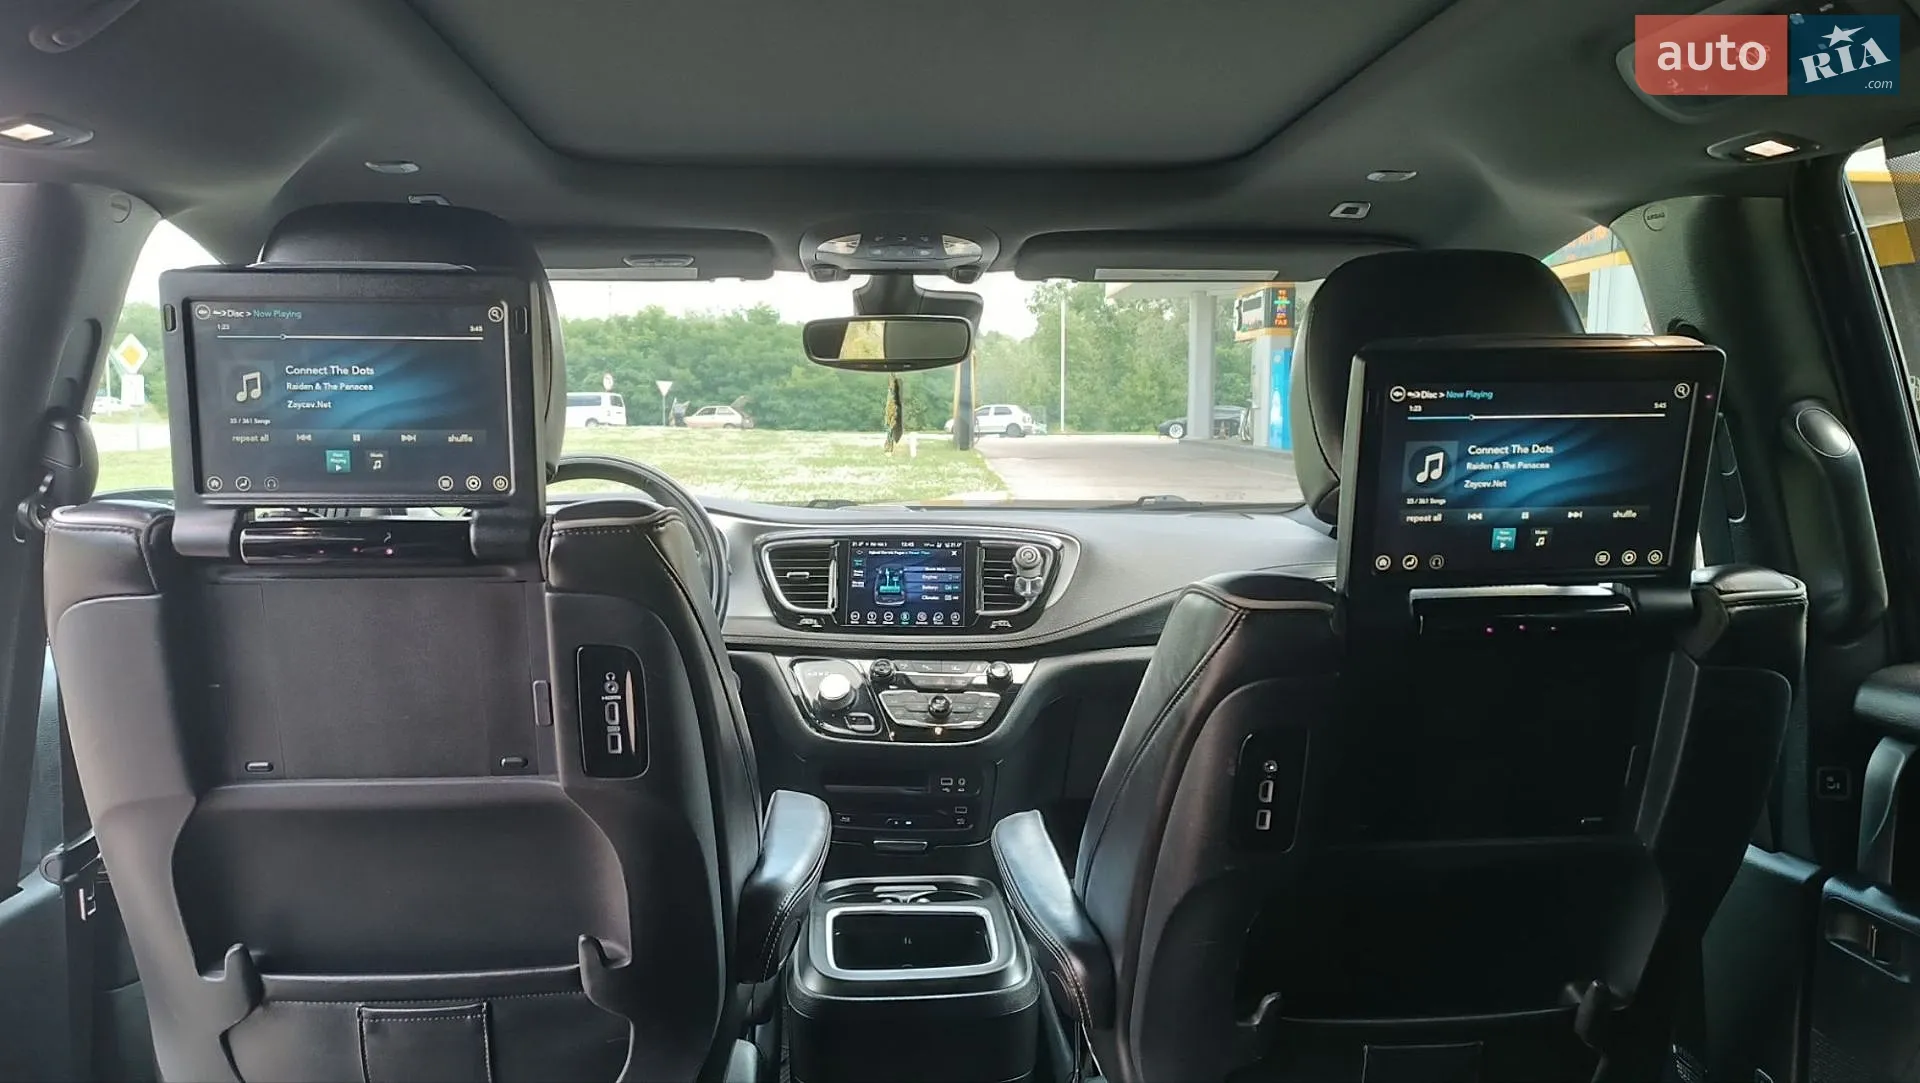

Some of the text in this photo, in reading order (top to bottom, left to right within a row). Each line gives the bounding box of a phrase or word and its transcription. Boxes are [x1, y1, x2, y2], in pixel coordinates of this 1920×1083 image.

[227, 309, 244, 318] Disc
[253, 310, 272, 318] Now
[273, 310, 302, 319] Playing
[285, 365, 375, 375] Connect The Dots
[286, 382, 314, 391] Raiden
[1421, 390, 1438, 399] Disc
[1446, 390, 1464, 398] Now
[1465, 389, 1493, 400] Playing
[232, 433, 269, 444] repeat all
[448, 434, 473, 442] shuffle
[1468, 444, 1554, 455] Connect The Dots
[1467, 461, 1550, 470] Raiden & The Panacea
[1406, 513, 1442, 524] repeat all
[1612, 510, 1637, 519] shuffle
